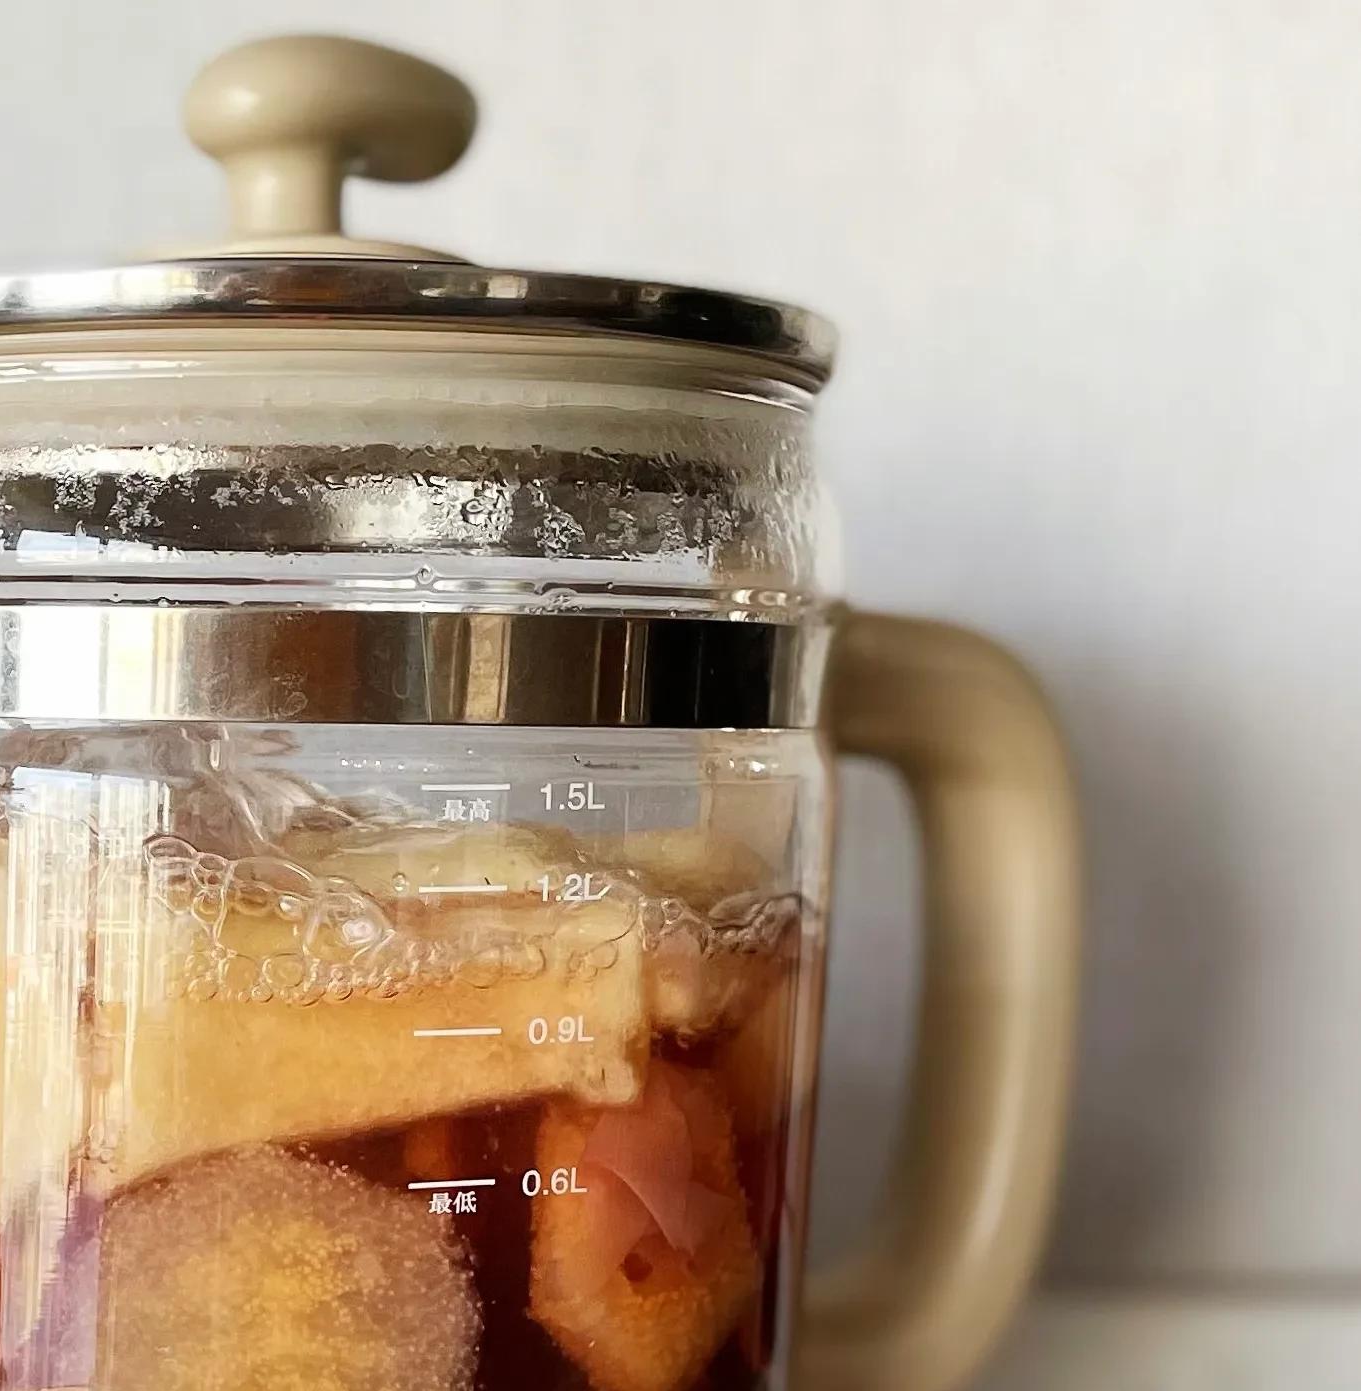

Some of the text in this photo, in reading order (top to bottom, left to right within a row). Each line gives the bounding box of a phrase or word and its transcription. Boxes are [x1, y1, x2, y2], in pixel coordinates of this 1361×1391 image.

[441, 799, 491, 822] 最高
[540, 782, 606, 811] 1.5L
[538, 873, 602, 903] 1.2L
[528, 1016, 595, 1046] 0.9L
[522, 1167, 588, 1197] 0.6L
[428, 1192, 478, 1215] 最低
